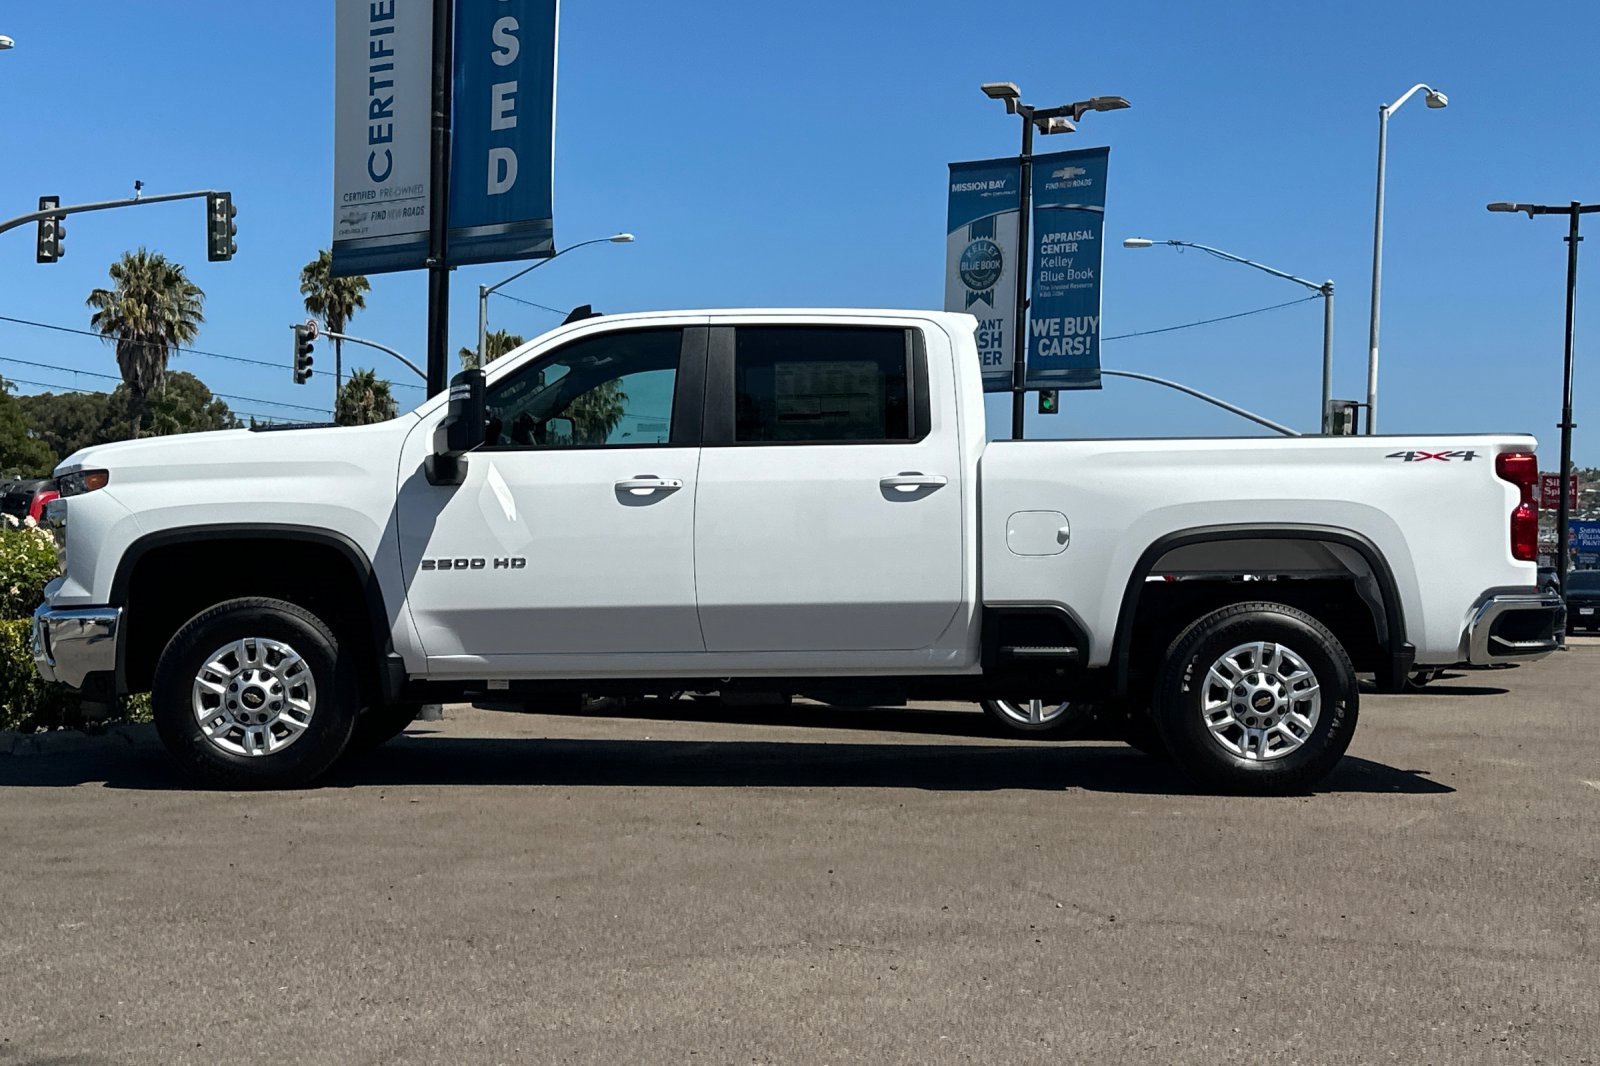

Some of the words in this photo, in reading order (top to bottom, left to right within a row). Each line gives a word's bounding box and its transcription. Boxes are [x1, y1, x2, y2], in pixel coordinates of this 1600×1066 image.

[487, 0, 520, 195] SED
[952, 182, 987, 192] MISSION
[988, 180, 1006, 189] BAY
[1045, 182, 1059, 191] FIND
[1072, 178, 1093, 188] ROADS
[343, 190, 376, 202] CERTIFIED
[380, 184, 424, 198] PRE-OWNED
[370, 210, 387, 221] FIND
[402, 206, 425, 218] ROADS
[1041, 230, 1094, 243] APPRAISAL
[966, 242, 998, 257] KELLEY
[1040, 242, 1079, 255] CENTER
[961, 260, 981, 272] BLUE
[980, 259, 1001, 270] BOOK
[1040, 255, 1074, 269] Kelley
[1040, 270, 1066, 282] Blue
[1067, 267, 1094, 280] Book
[978, 318, 1003, 331] ANT
[1031, 318, 1061, 337] WE
[1063, 316, 1100, 336] BUY
[978, 331, 1003, 350] SH
[1038, 336, 1092, 357] CARS!
[421, 559, 485, 570] 2500
[493, 558, 526, 569] HD
